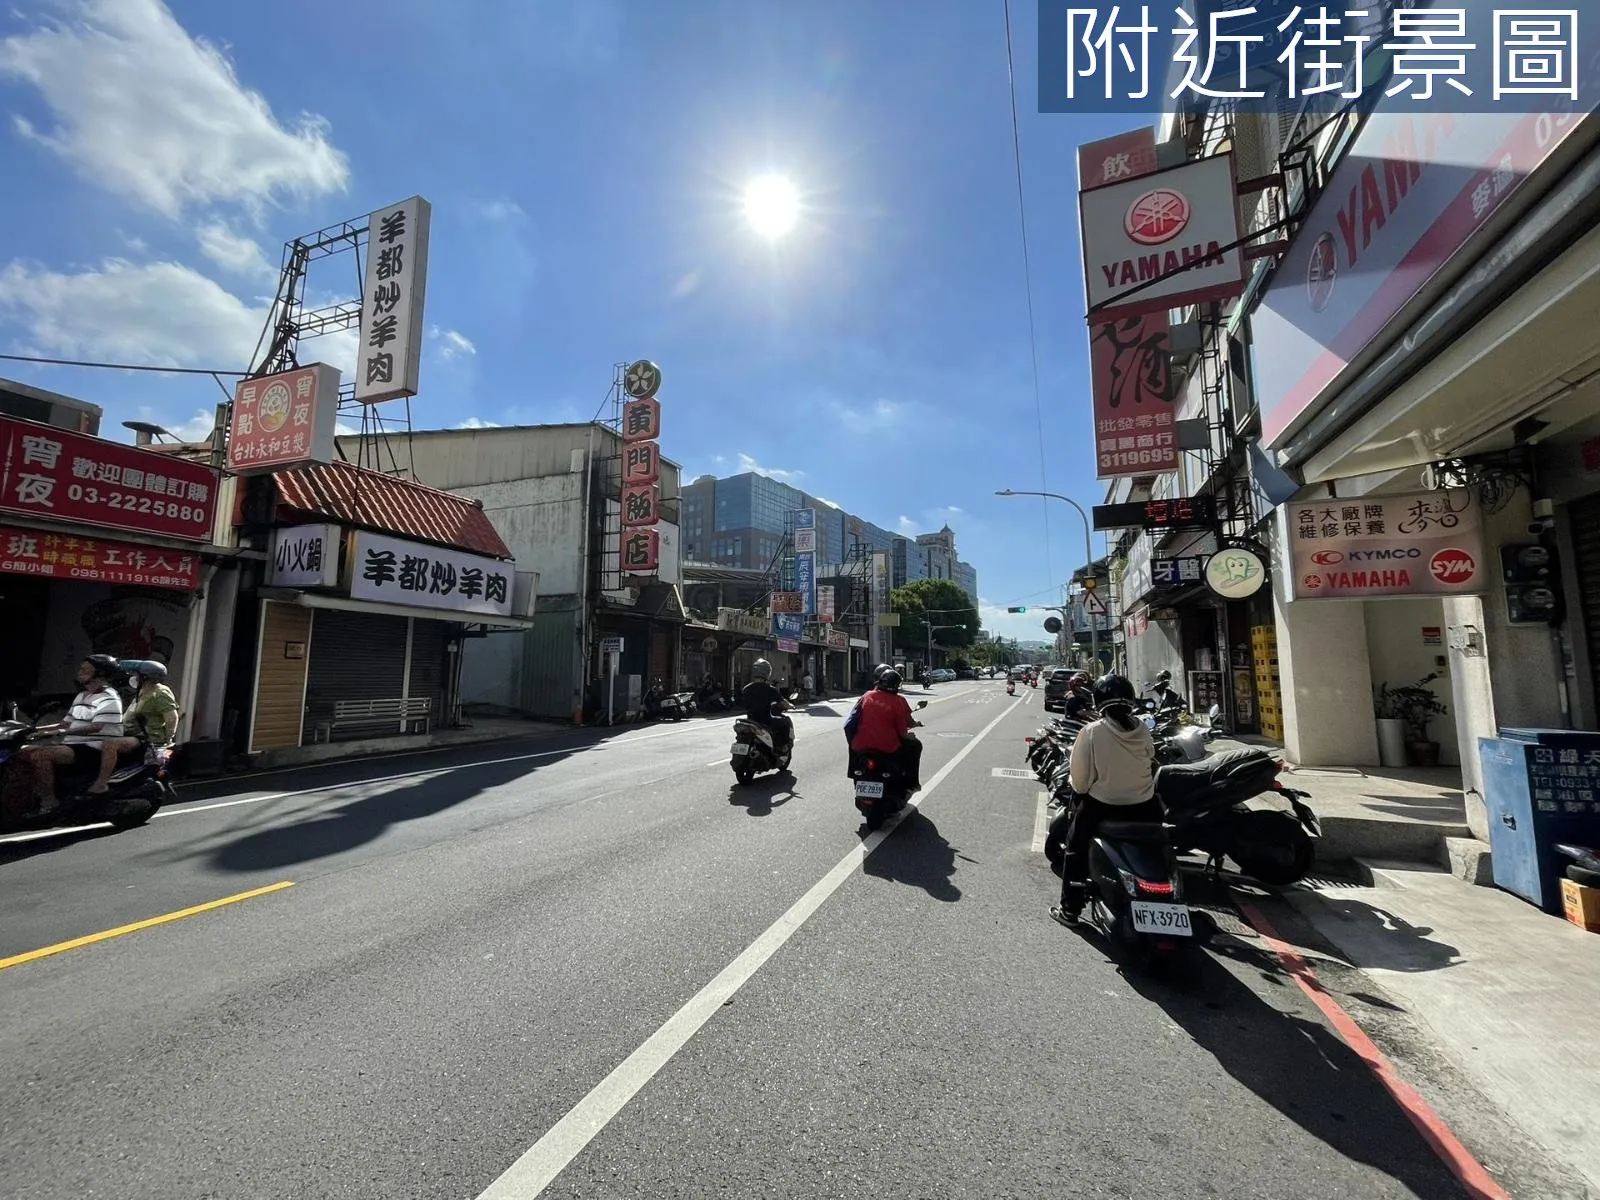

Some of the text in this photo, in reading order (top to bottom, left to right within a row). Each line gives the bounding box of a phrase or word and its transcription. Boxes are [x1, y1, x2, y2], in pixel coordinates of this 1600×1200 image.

[1102, 153, 1132, 181] 飲
[1102, 241, 1225, 288] YAMAHA
[366, 210, 406, 386] 羊都炒羊肉
[237, 387, 257, 436] 早點
[293, 375, 313, 427] 宵夜
[1100, 413, 1172, 433] 批發零售
[234, 432, 304, 461] 台北永和豆漿
[1100, 448, 1175, 468] 3119695
[15, 436, 63, 507] 宵夜
[71, 457, 208, 503] 歡迎團體訂購
[67, 484, 206, 523] 03-2225880
[1298, 505, 1384, 523] 各大廠牌
[1299, 521, 1385, 539] 維修保養
[103, 549, 192, 575] 工作人員
[276, 538, 322, 572] 小火鍋
[1349, 548, 1421, 561] KYMCO
[1431, 559, 1474, 577] SYM
[363, 548, 507, 604] 羊都炒羊肉
[1326, 569, 1411, 588] YAMAHA
[1134, 909, 1188, 928] NFX-3920
